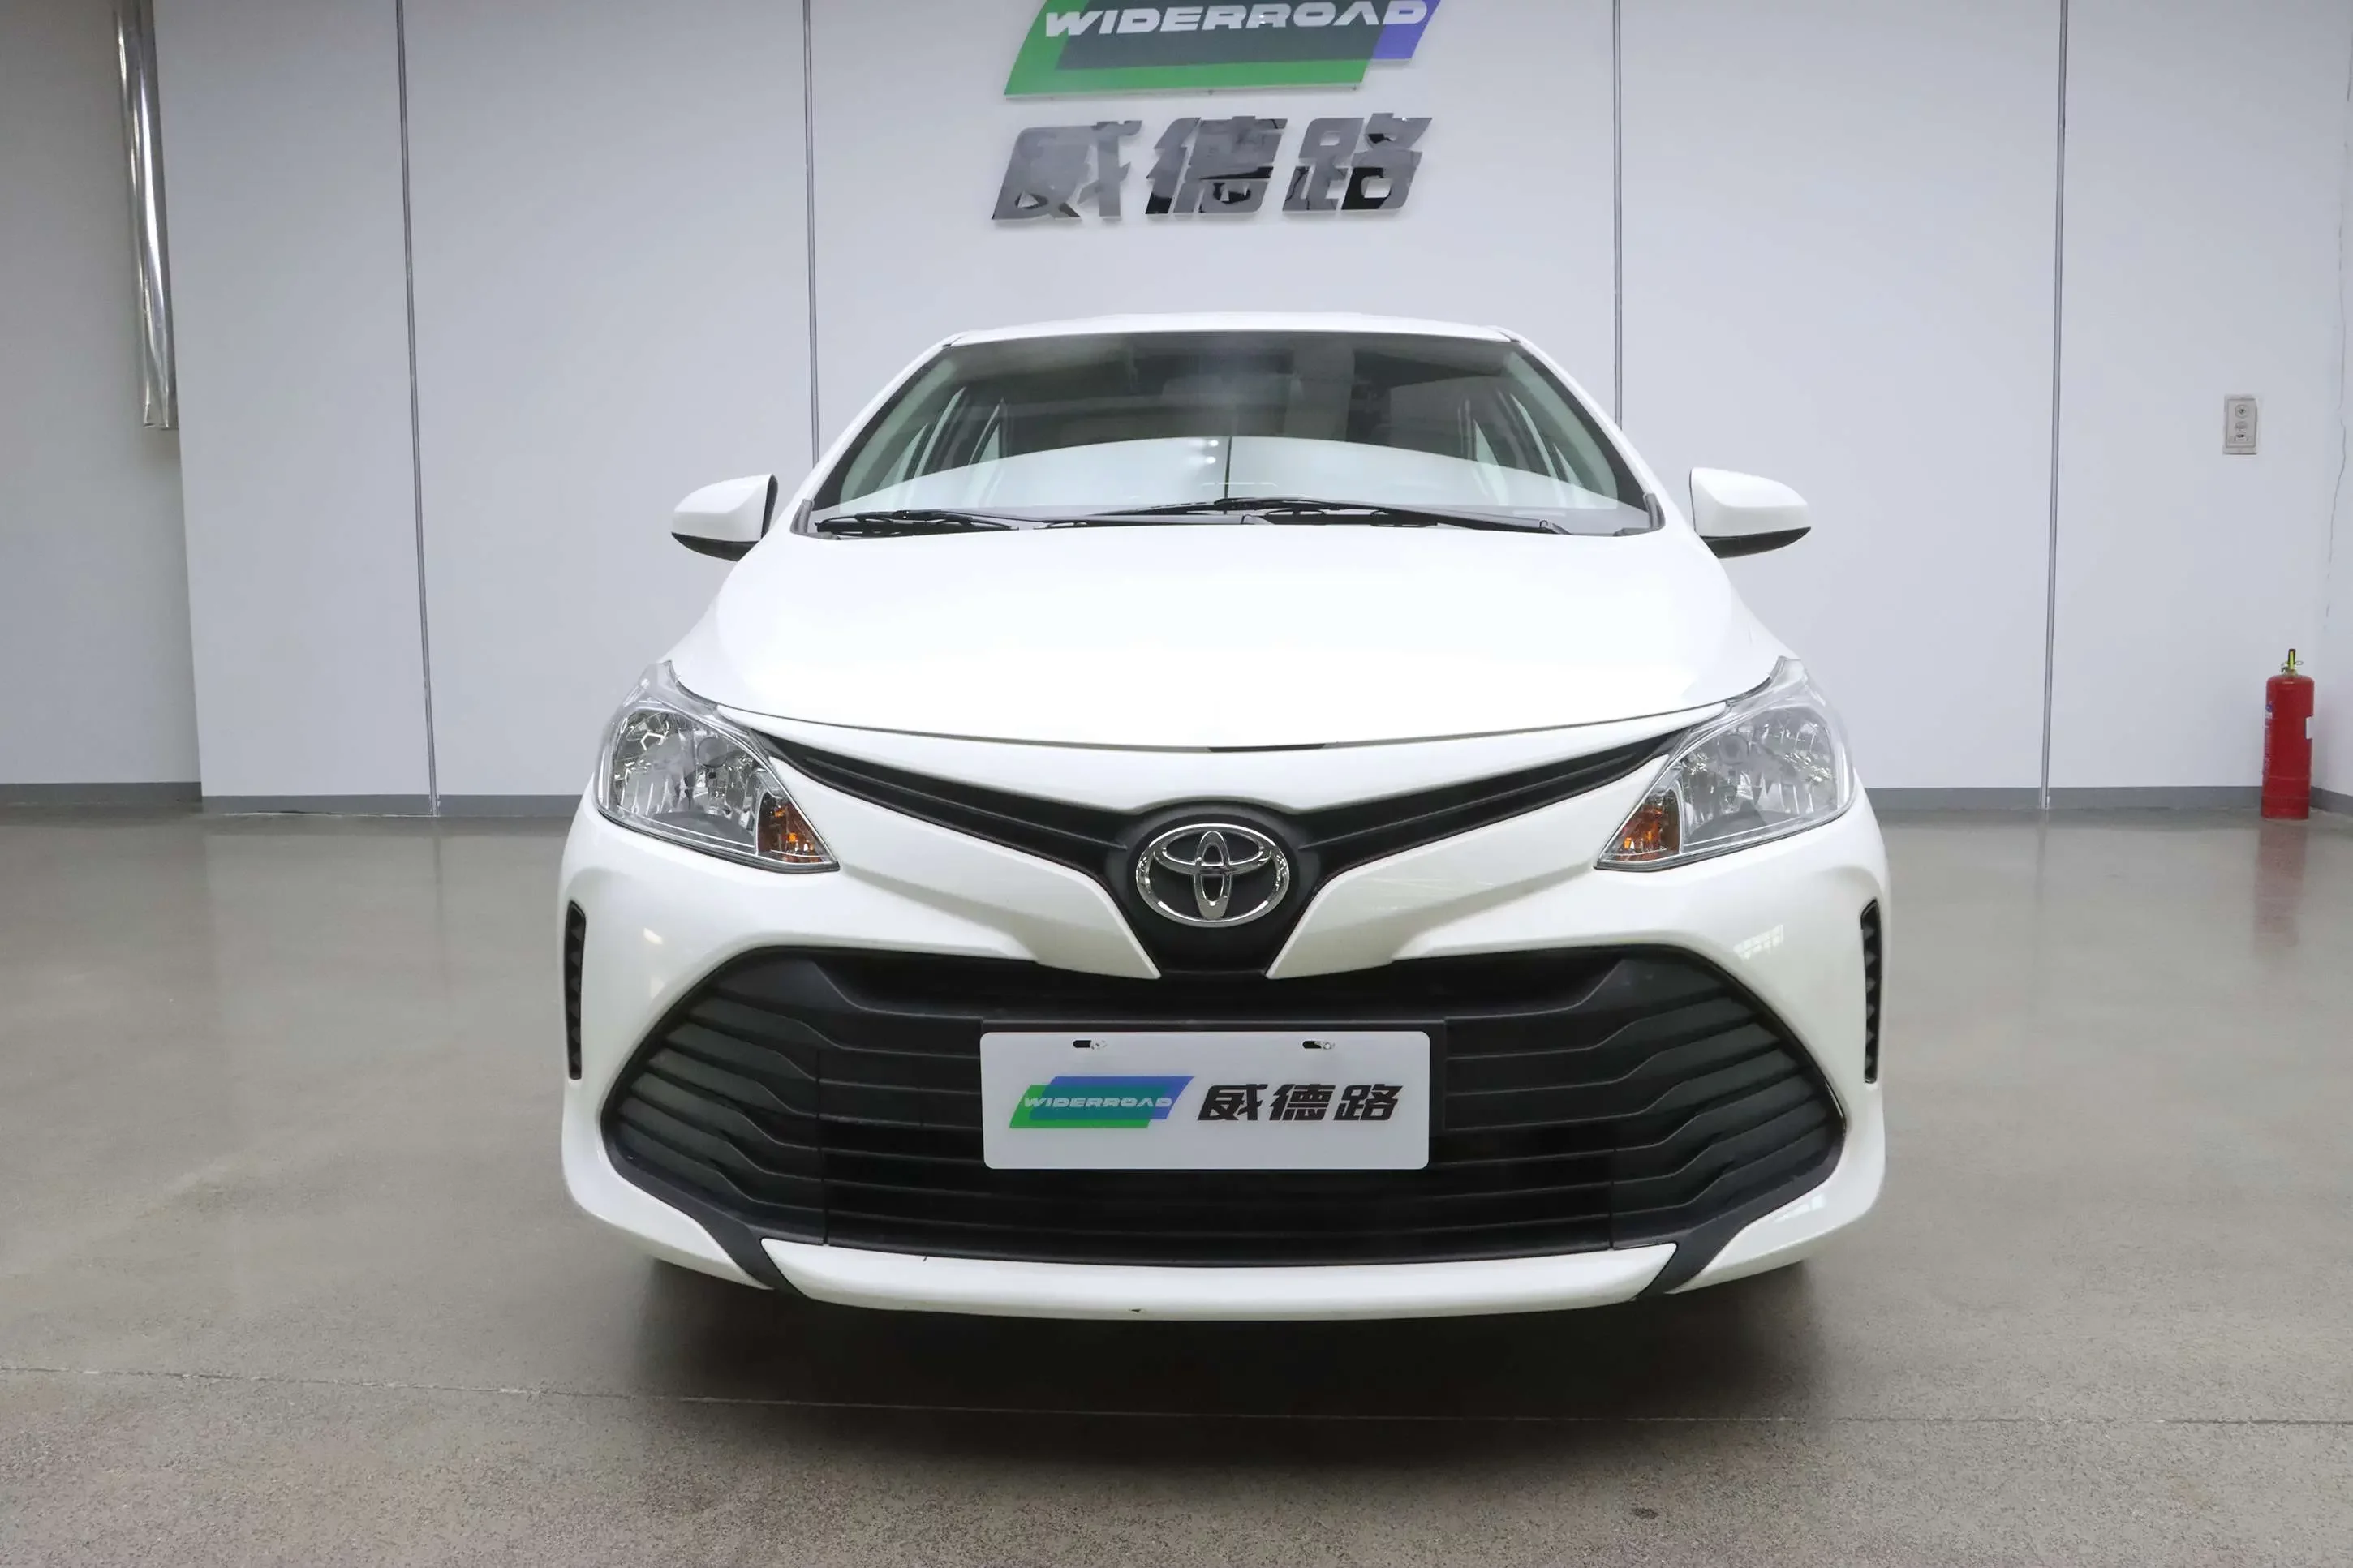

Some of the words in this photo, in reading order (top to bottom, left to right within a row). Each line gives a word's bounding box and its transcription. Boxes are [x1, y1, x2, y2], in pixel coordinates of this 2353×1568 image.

[1045, 0, 1427, 37] WIDERROAD
[992, 113, 1433, 220] 威德路
[1023, 1097, 1173, 1108] WIDERROAD
[1197, 1083, 1404, 1122] 威德路
